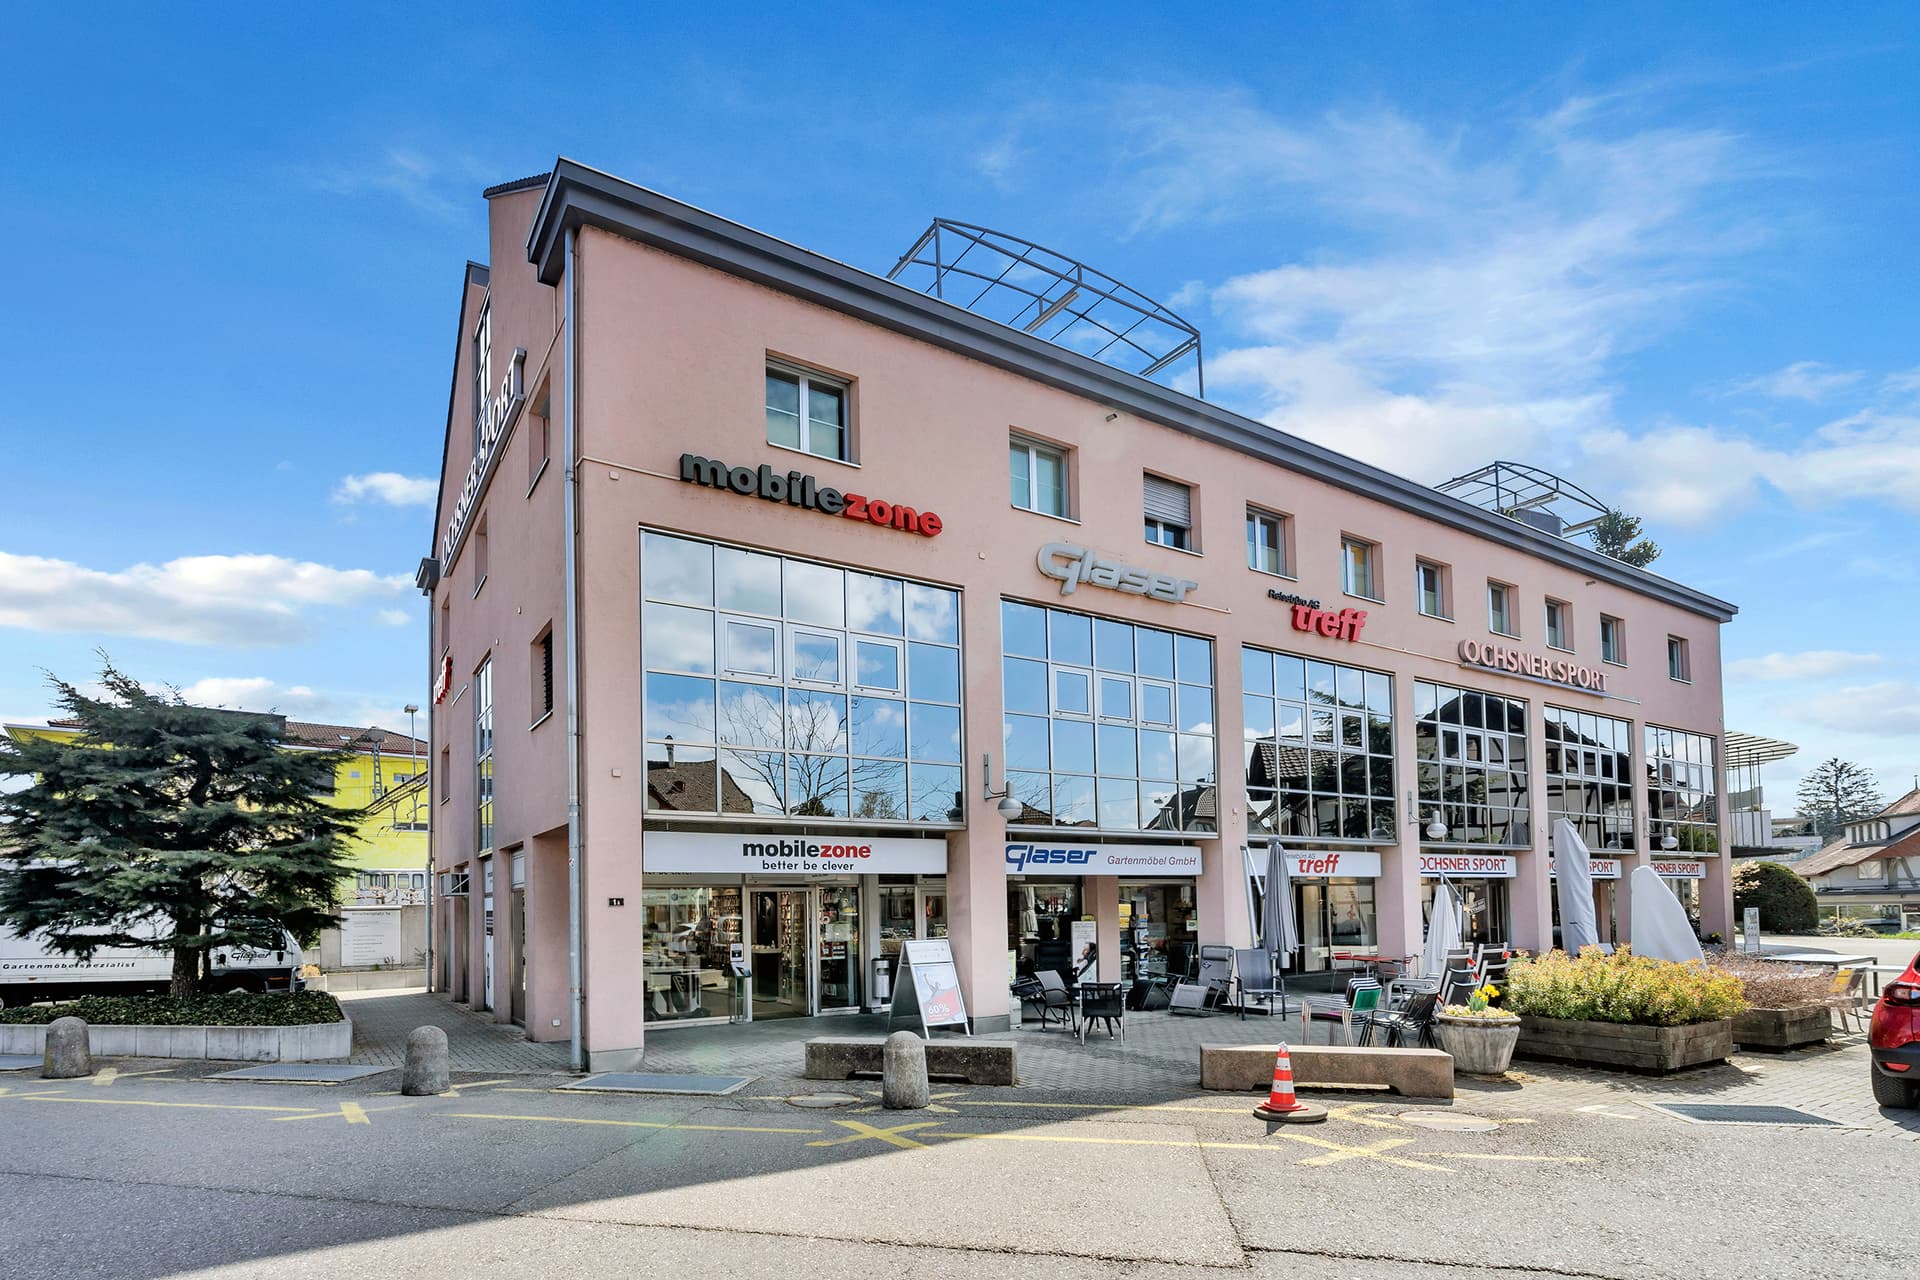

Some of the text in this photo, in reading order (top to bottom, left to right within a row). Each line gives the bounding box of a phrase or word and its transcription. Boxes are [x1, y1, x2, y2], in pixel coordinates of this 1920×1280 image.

[442, 361, 516, 567] OCHSNER SPORT
[680, 453, 943, 538] mobilezone
[1036, 541, 1199, 604] Glaser
[1290, 604, 1368, 642] treff
[1458, 638, 1609, 692] OCHSNER SPORT
[742, 839, 872, 859] mobilezone
[1005, 844, 1197, 872] Glaser Gartenmöbel GmbH
[762, 860, 855, 871] better be clever
[1298, 853, 1340, 874] treff
[1472, 858, 1507, 872] SPORT
[1677, 863, 1700, 874] SPORT
[927, 1003, 950, 1015] 60%
